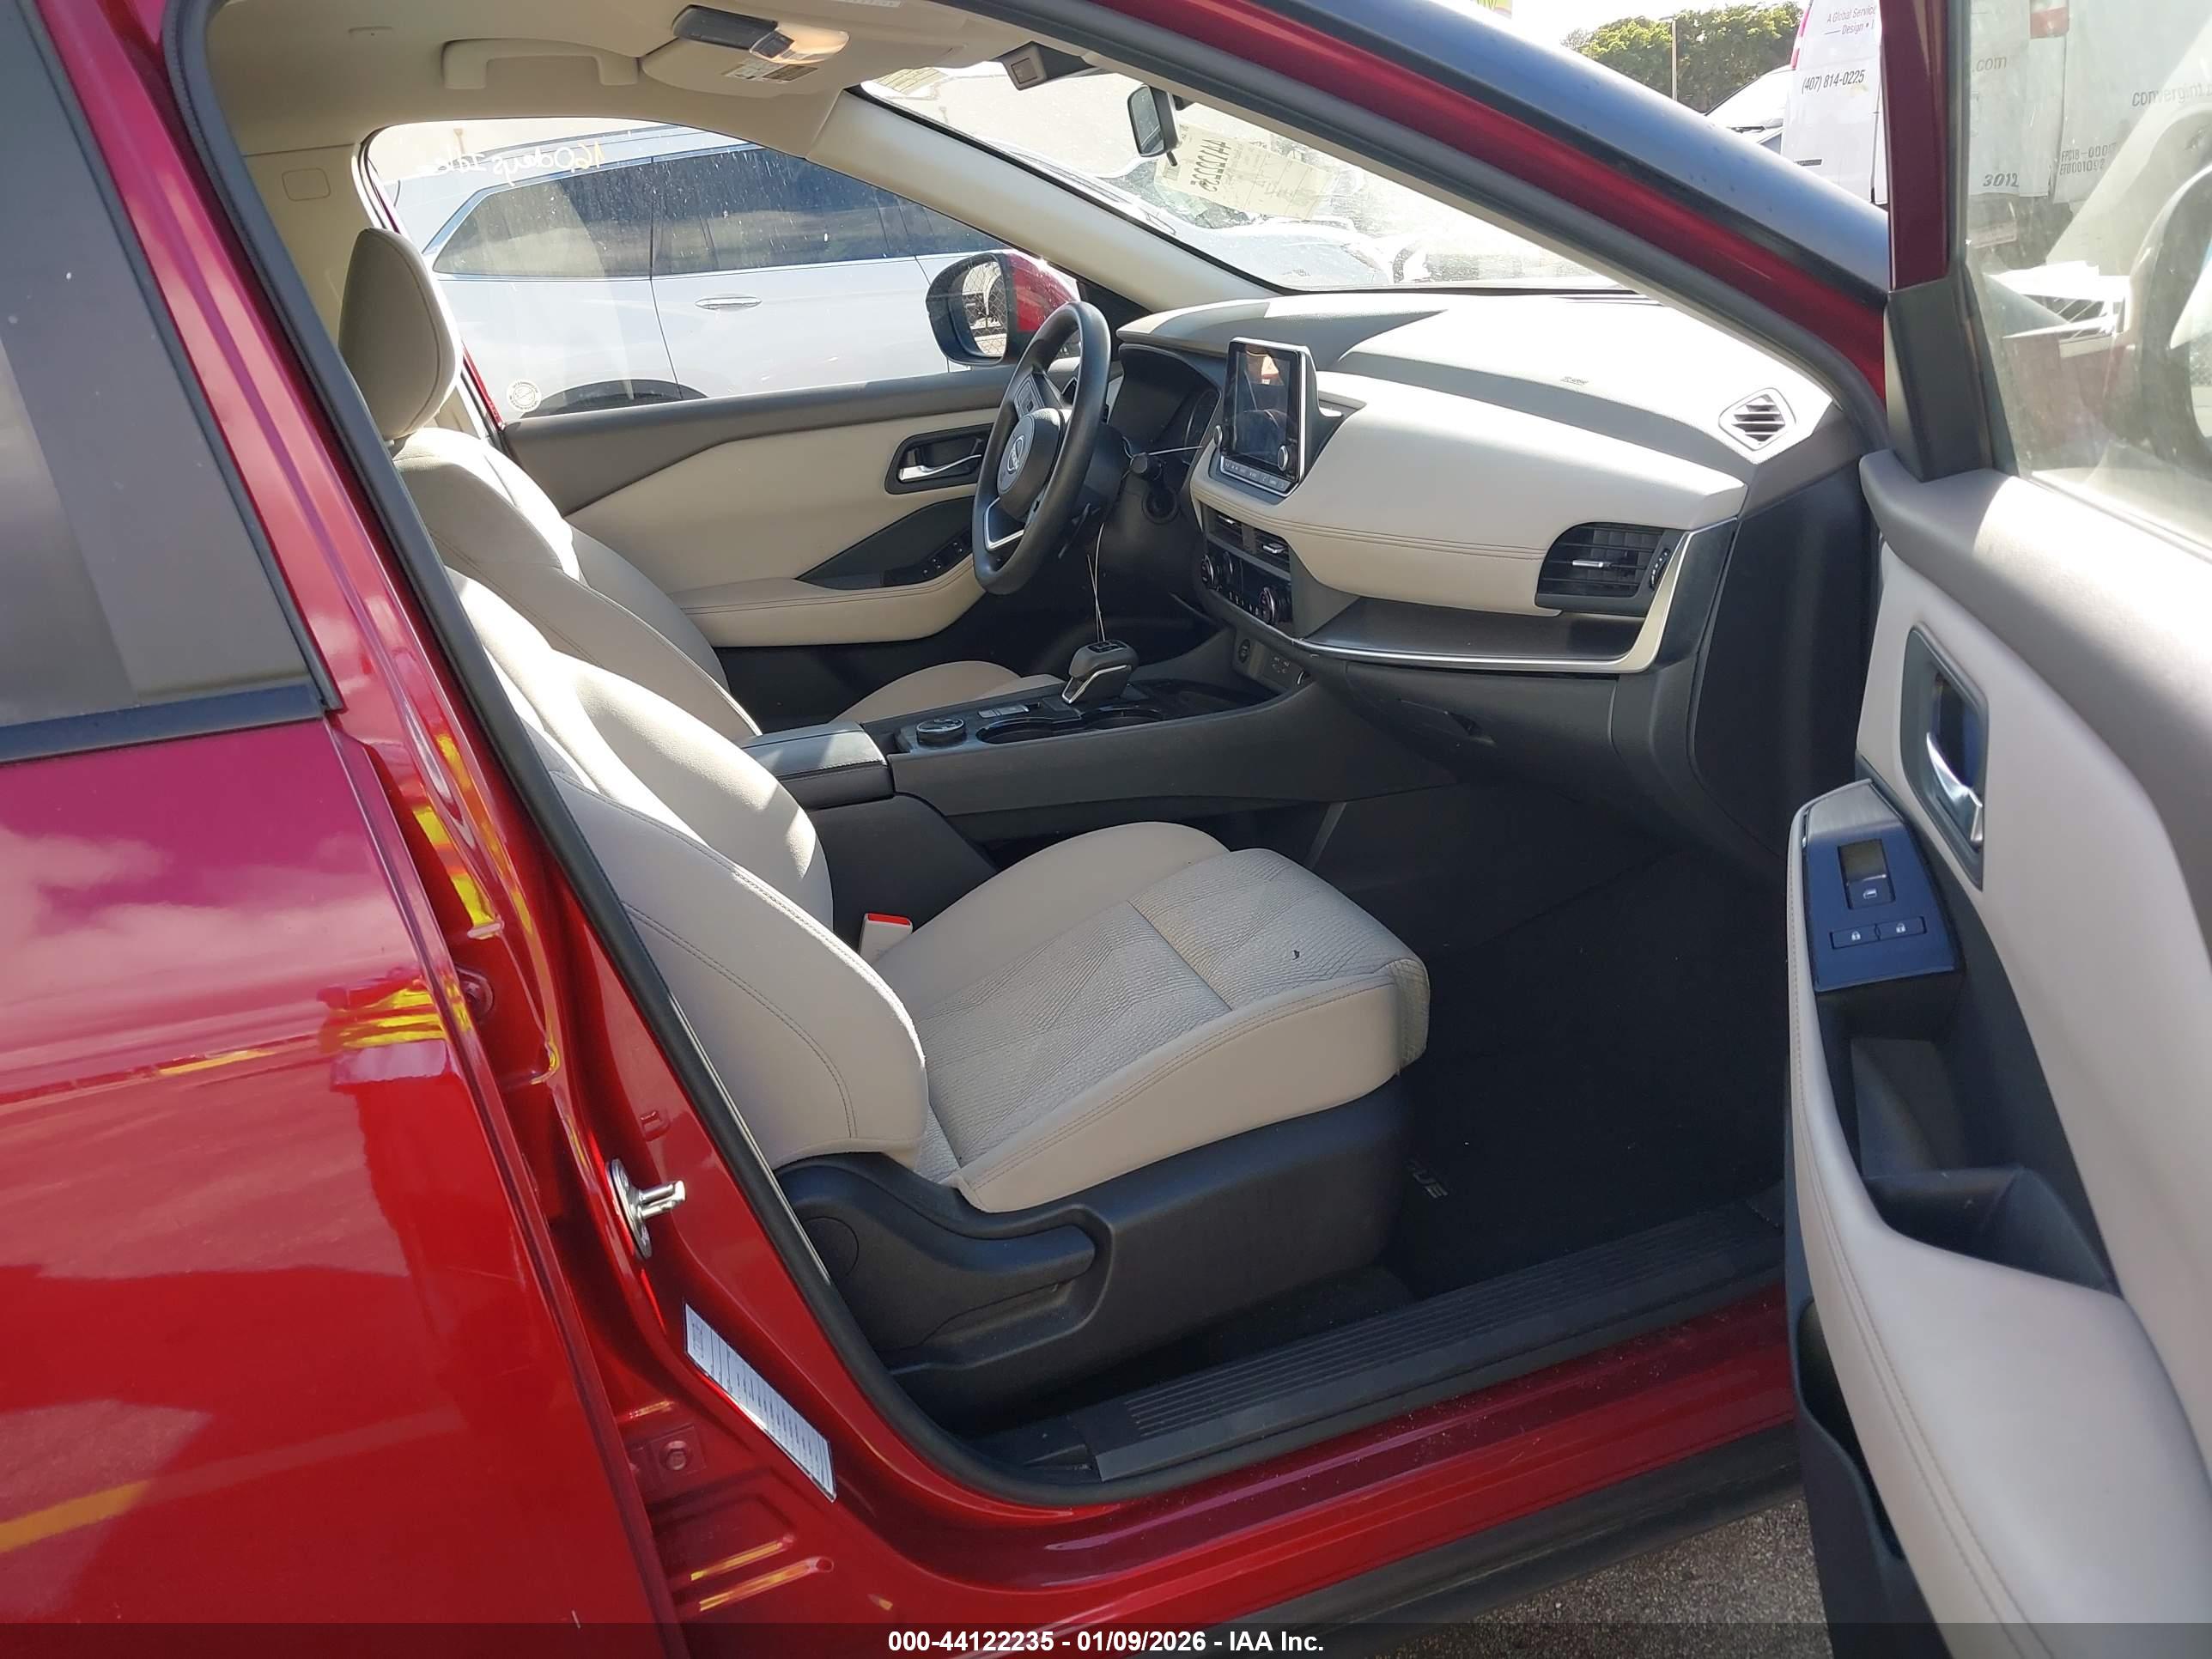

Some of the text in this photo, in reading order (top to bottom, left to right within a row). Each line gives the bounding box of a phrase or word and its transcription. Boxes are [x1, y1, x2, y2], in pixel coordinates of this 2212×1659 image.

[1833, 9, 1851, 22] Global
[1841, 22, 1864, 35] Design
[1802, 69, 1866, 94] (407) 814-0225
[1982, 173, 2020, 188] 3012
